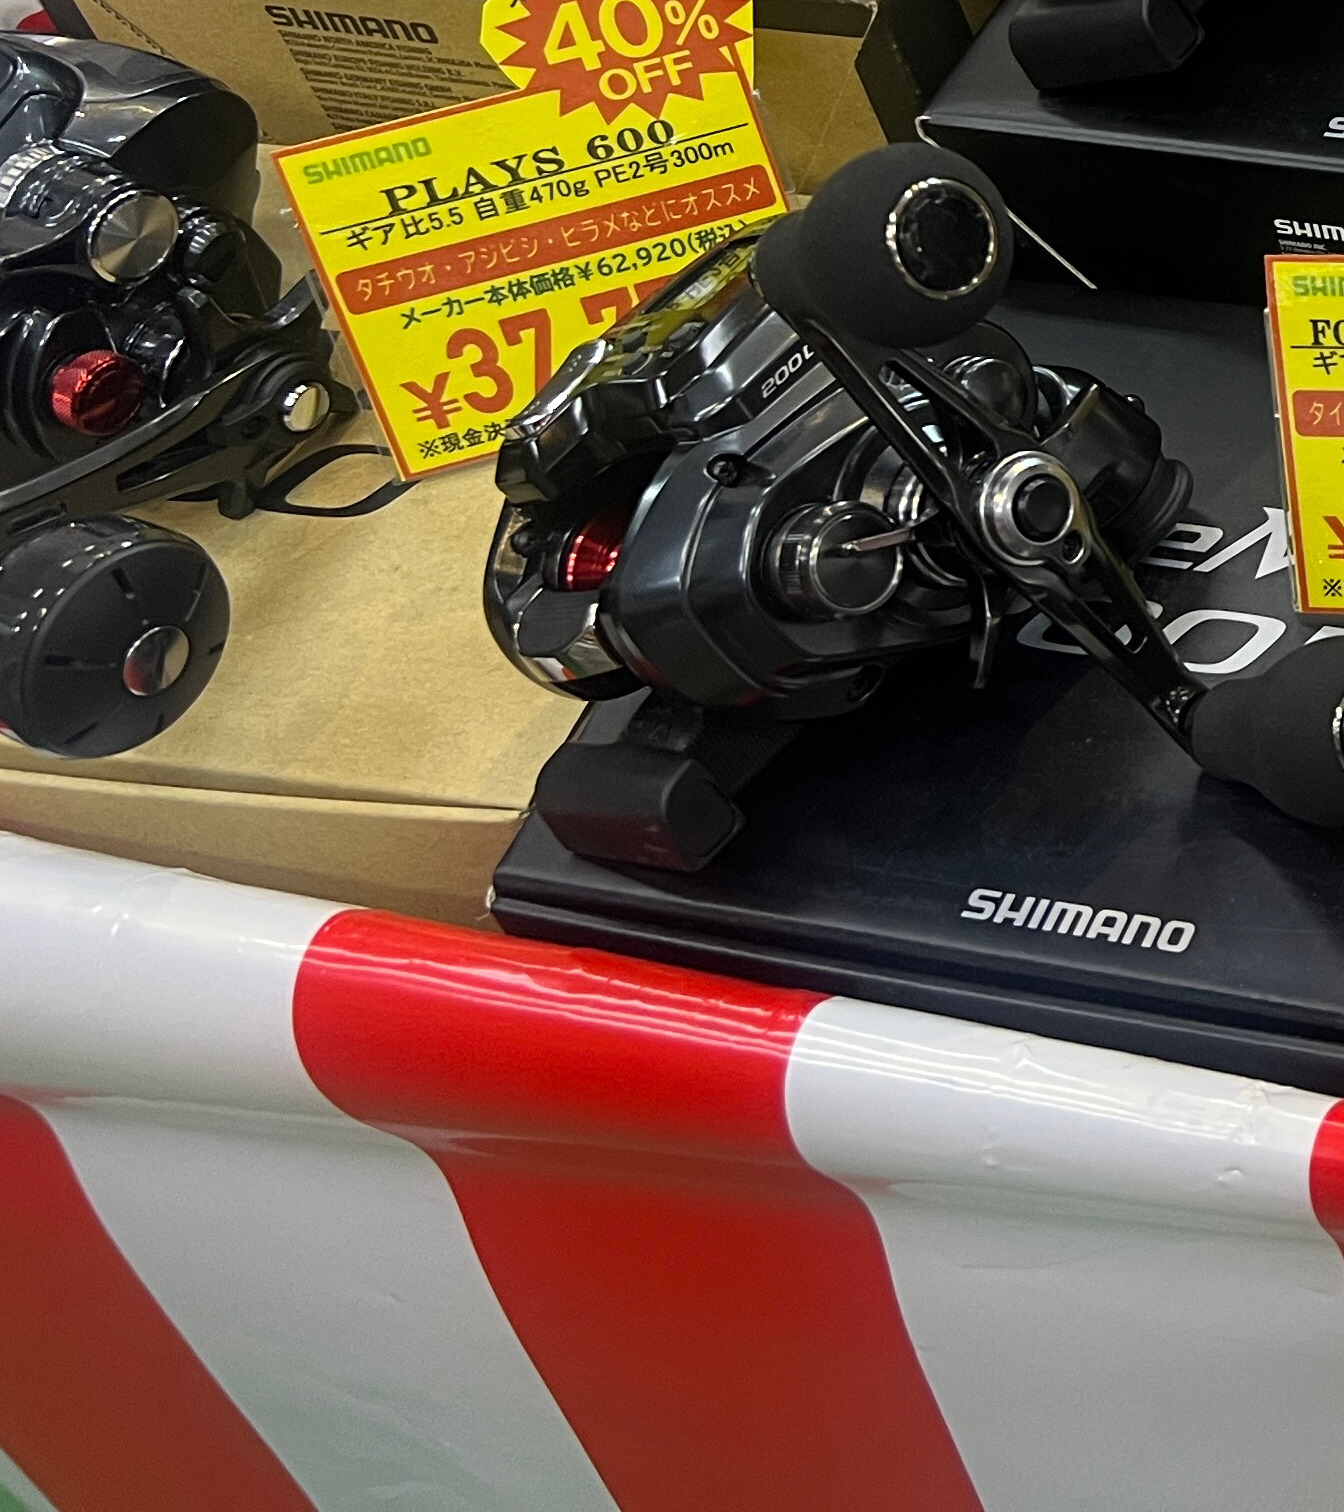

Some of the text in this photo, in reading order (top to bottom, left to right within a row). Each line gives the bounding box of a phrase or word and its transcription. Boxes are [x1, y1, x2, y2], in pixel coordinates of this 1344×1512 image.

[265, 5, 439, 43] SHIMANO
[599, 52, 694, 101] OFF
[303, 137, 431, 184] SHIMANO
[380, 120, 675, 217] PLAYS 600
[347, 140, 735, 253] ギア比5.5 自重470g PE2号300m
[961, 887, 1197, 954] SHIMANO
